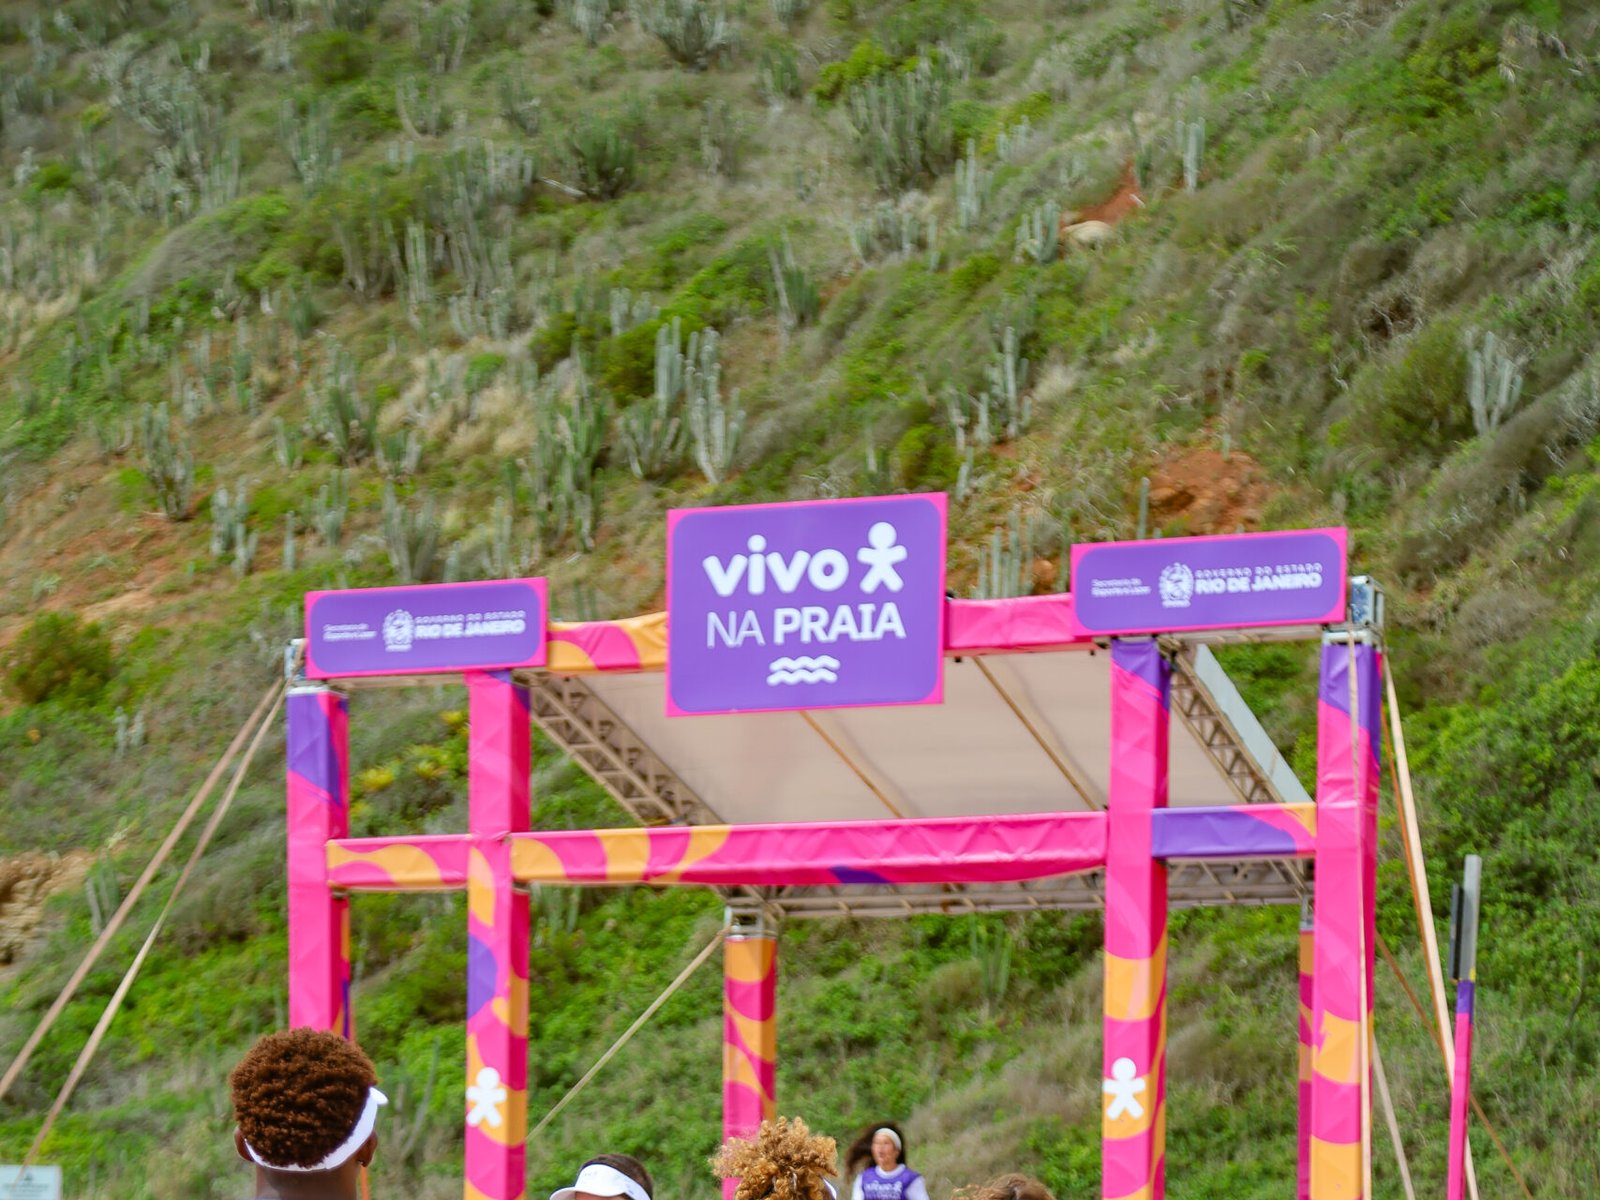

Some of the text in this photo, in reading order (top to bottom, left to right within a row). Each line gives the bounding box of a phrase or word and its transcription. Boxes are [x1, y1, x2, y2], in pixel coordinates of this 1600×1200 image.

[702, 534, 850, 597] vivo
[1195, 573, 1323, 595] RIO DE JANEIRO
[414, 619, 527, 640] RIO DE JANEIRO
[706, 601, 908, 649] NA PRAIA
